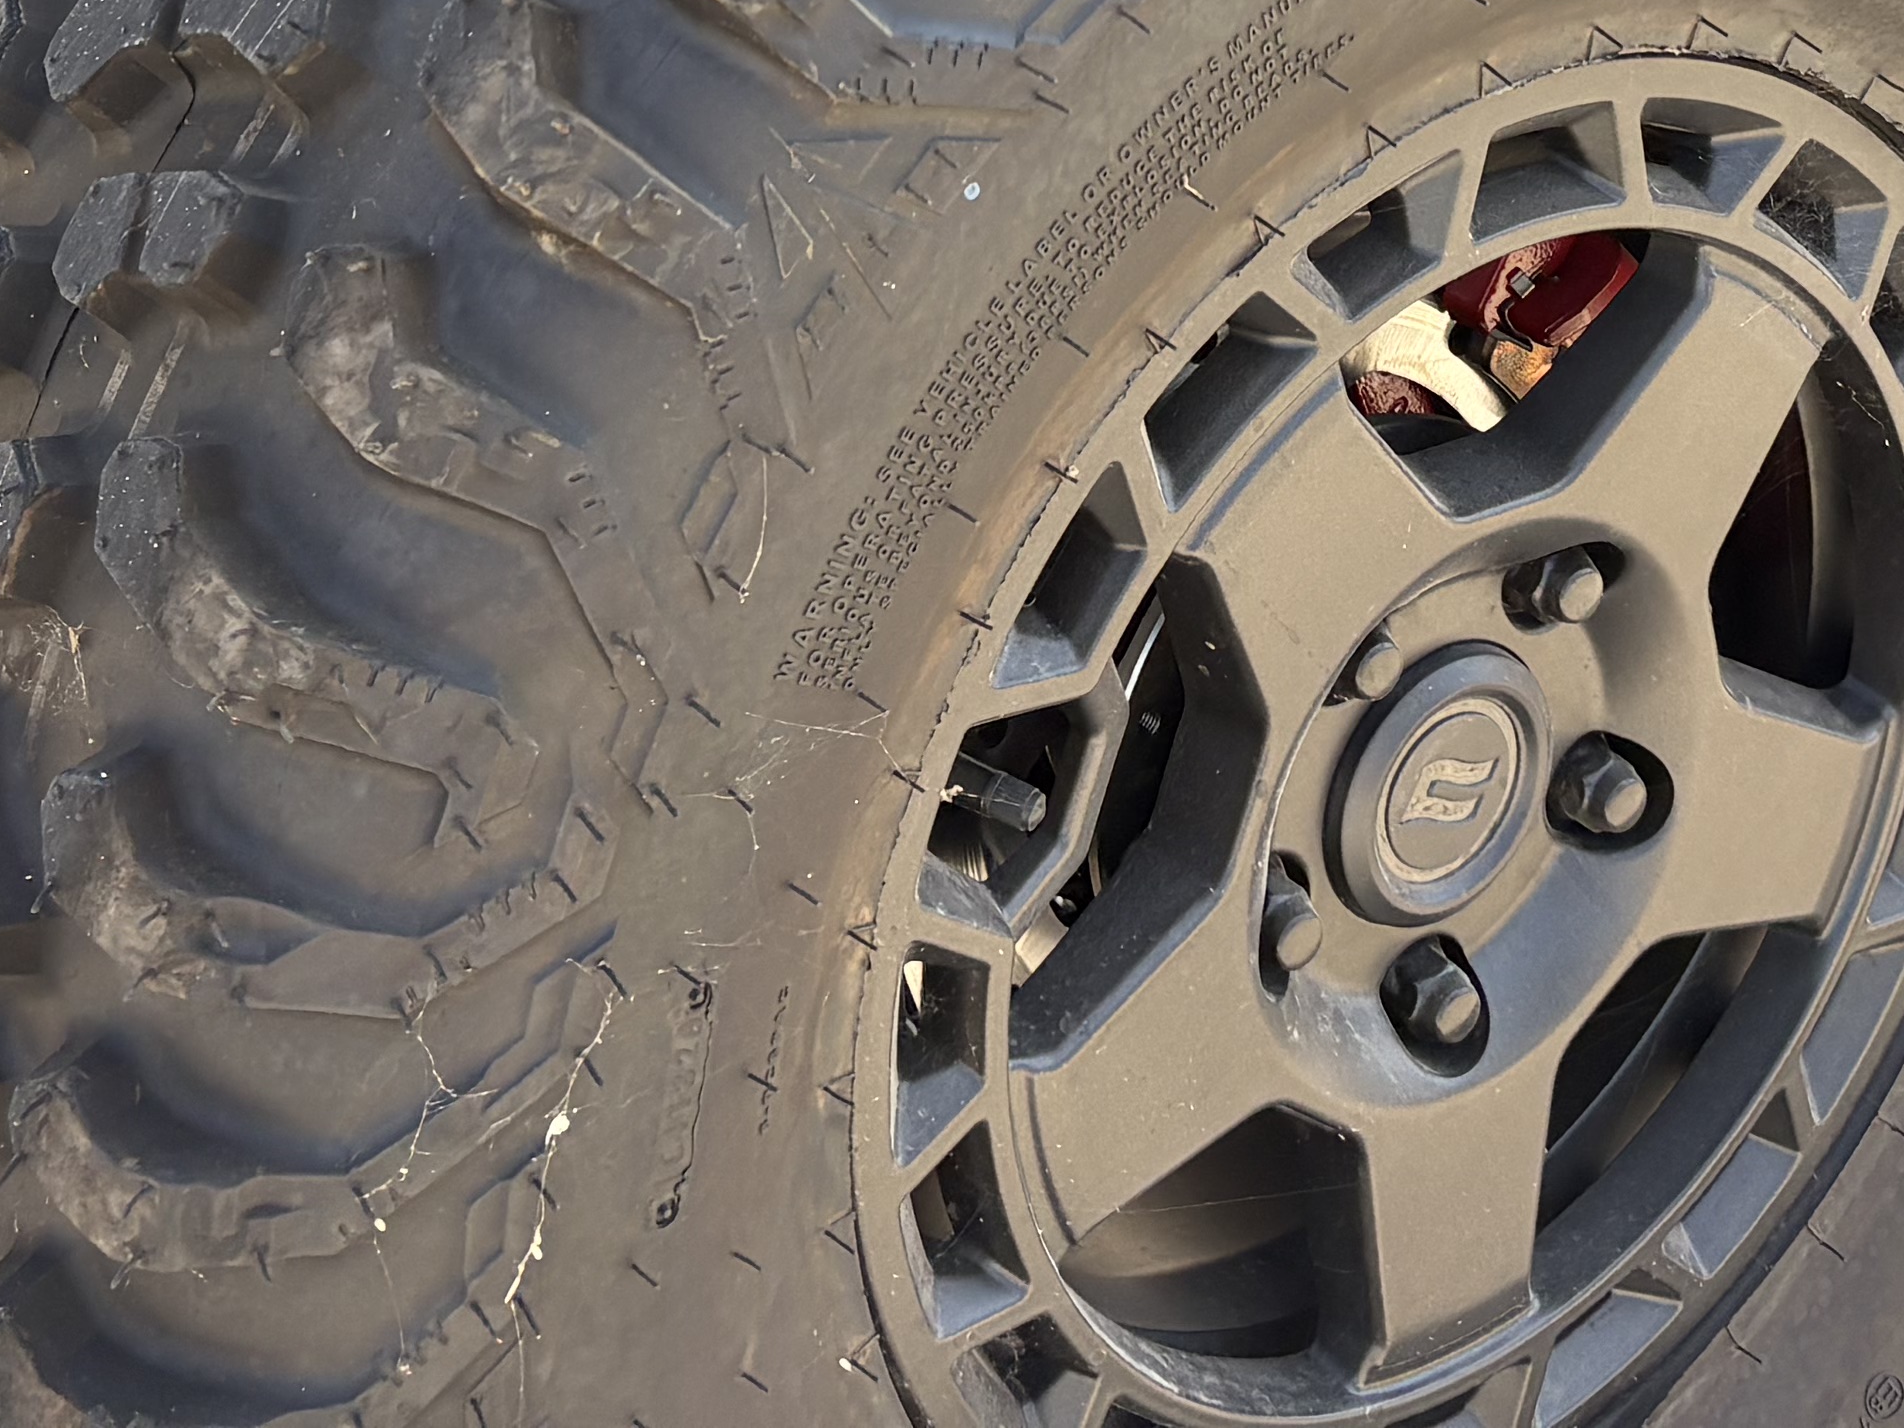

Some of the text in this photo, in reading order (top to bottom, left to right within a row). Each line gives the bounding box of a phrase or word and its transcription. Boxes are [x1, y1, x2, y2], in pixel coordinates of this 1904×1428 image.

[772, 490, 878, 683] WARNING:
[872, 422, 917, 485] SEE
[912, 291, 1007, 424] VEHICLE
[1002, 200, 1078, 297] LABEL
[1115, 52, 1222, 166] OWNER'S
[794, 622, 837, 688] FOR
[827, 430, 937, 616] OPERATING
[932, 262, 1053, 430] PRESSURE.
[1081, 142, 1161, 235] REDUCE
[1161, 98, 1204, 149] THE
[1206, 50, 1257, 106] RISK
[813, 567, 879, 690] SERIOUS
[897, 426, 956, 516] FATAL
[951, 328, 1022, 427] INJURY
[1022, 275, 1064, 328] DUE
[1248, 41, 1290, 89] NOT
[826, 570, 891, 691] INFLATE
[886, 455, 954, 564] BEYOND
[1090, 197, 1146, 264] WHEN
[1147, 106, 1235, 199] SEATING
[963, 340, 1045, 455] TRAINED
[1042, 231, 1132, 343] PERSONS
[1214, 82, 1284, 153] MOUNT
